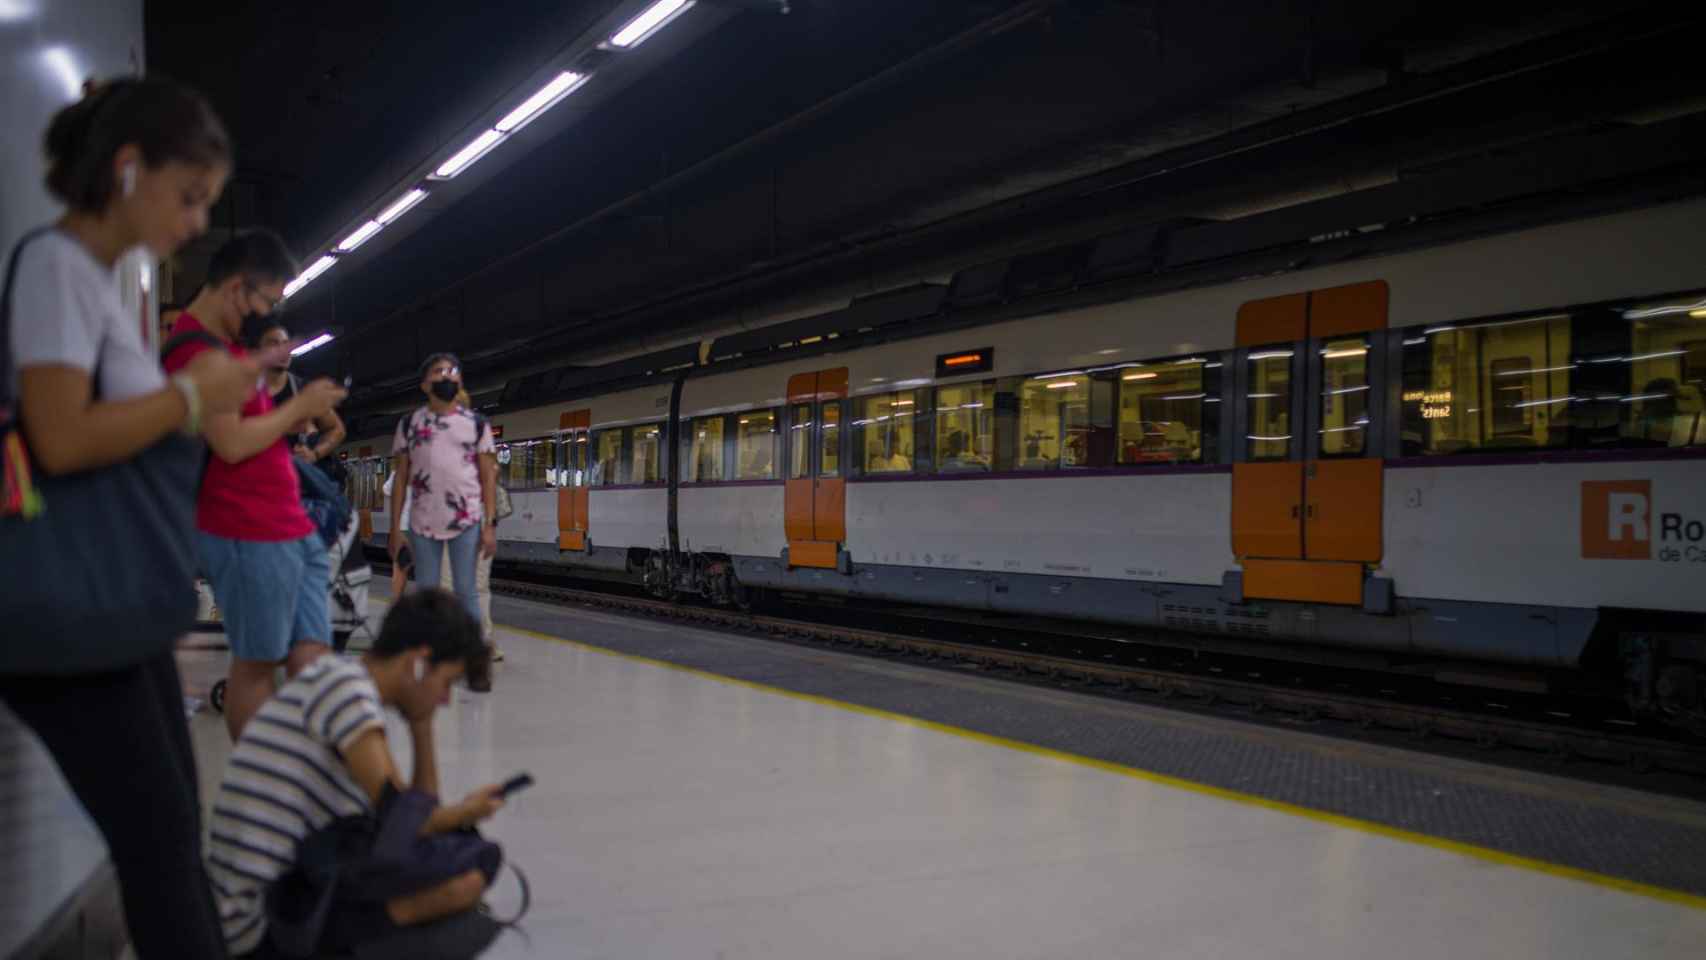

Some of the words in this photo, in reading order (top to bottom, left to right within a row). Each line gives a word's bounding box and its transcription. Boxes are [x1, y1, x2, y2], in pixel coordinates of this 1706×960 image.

[1608, 491, 1648, 541] R
[1661, 513, 1705, 542] Ro
[1660, 545, 1681, 562] de
